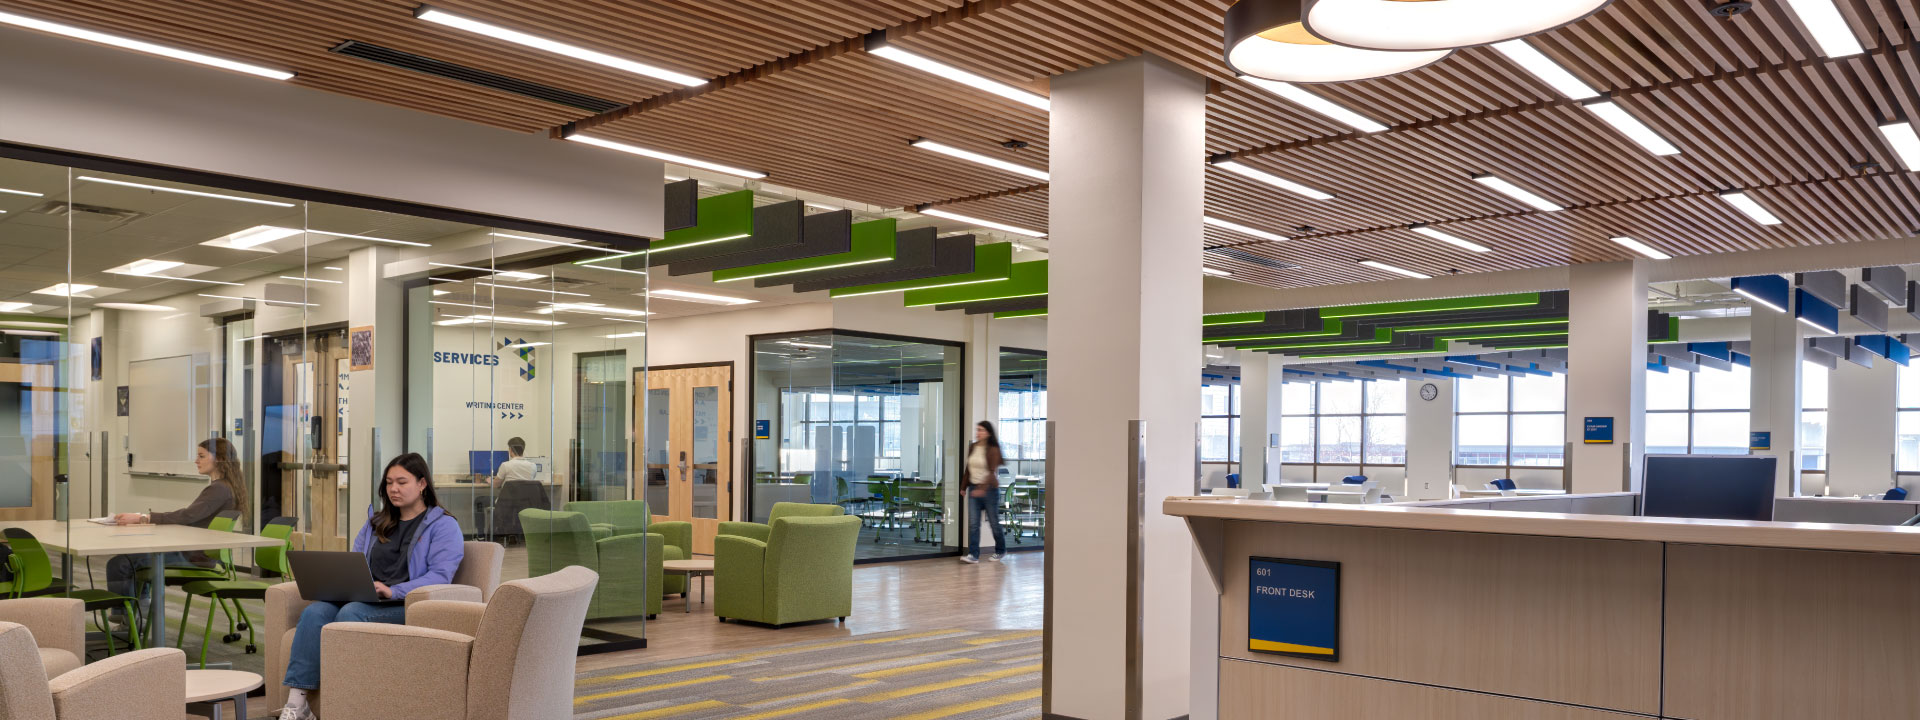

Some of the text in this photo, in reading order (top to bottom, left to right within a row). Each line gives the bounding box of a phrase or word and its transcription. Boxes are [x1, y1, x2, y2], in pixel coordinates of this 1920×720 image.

[433, 351, 500, 366] SERVICES
[497, 402, 524, 410] CENTER
[1256, 567, 1271, 576] 601
[1256, 585, 1315, 599] FRONT DESK
